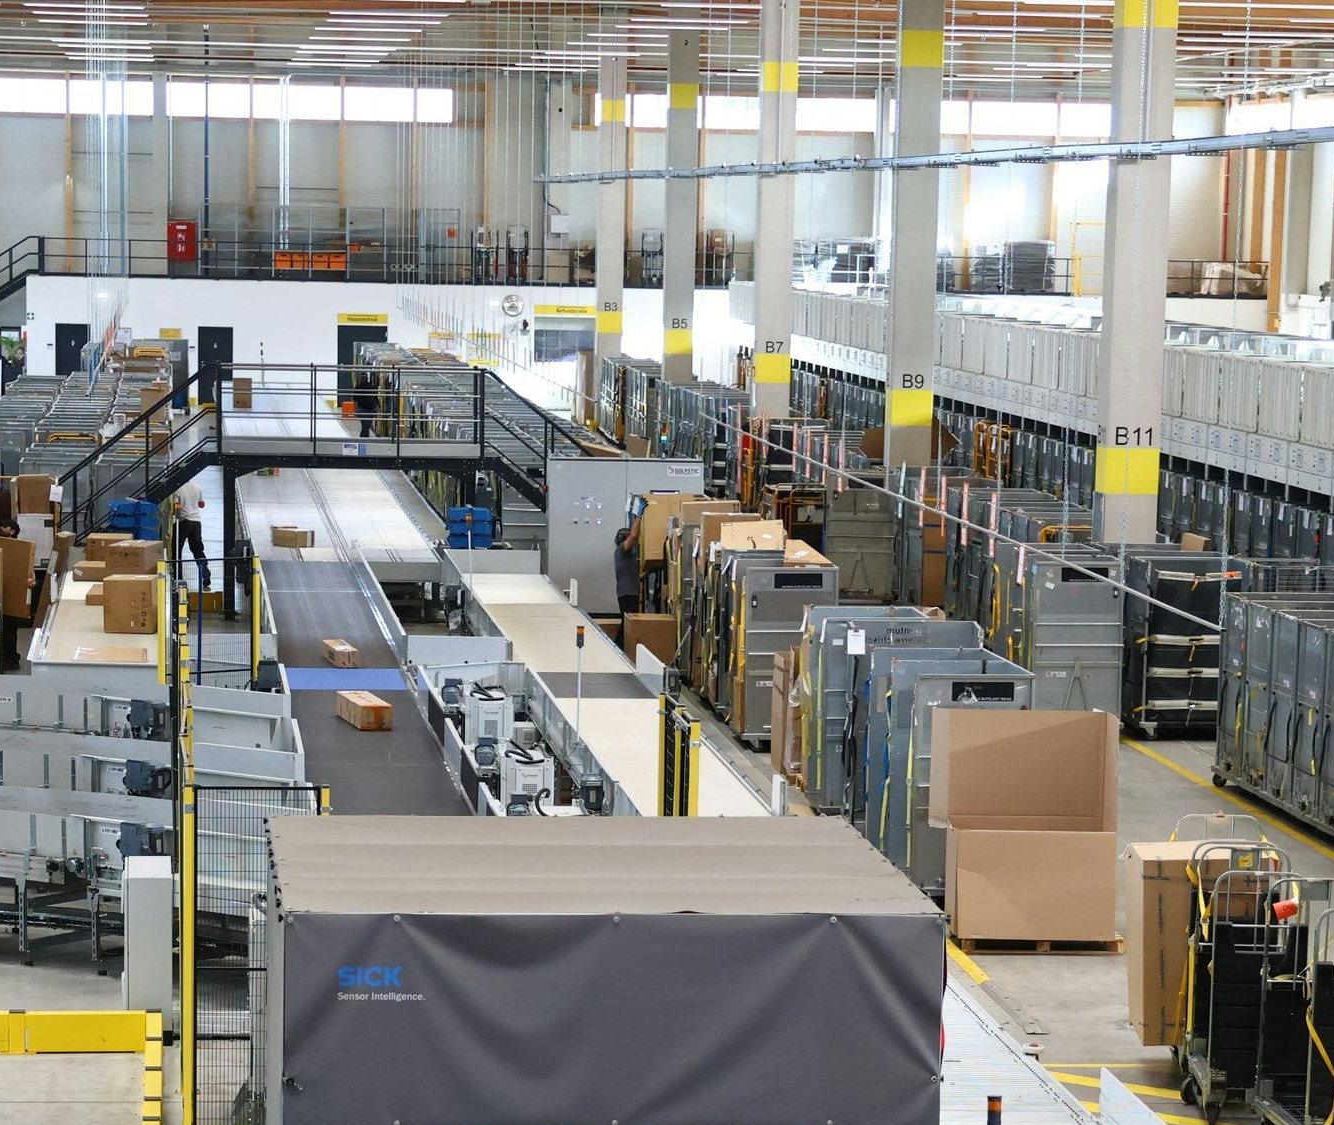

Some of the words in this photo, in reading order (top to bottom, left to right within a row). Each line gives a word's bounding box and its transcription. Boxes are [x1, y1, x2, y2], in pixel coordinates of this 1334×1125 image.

[604, 302, 618, 311] B3
[672, 318, 688, 329] B5
[765, 341, 783, 353] B7
[902, 374, 924, 389] B9
[1115, 426, 1153, 446] B11
[338, 965, 402, 988] SICK
[337, 991, 370, 1001] Sensor
[371, 991, 427, 1003] Intelligence.
